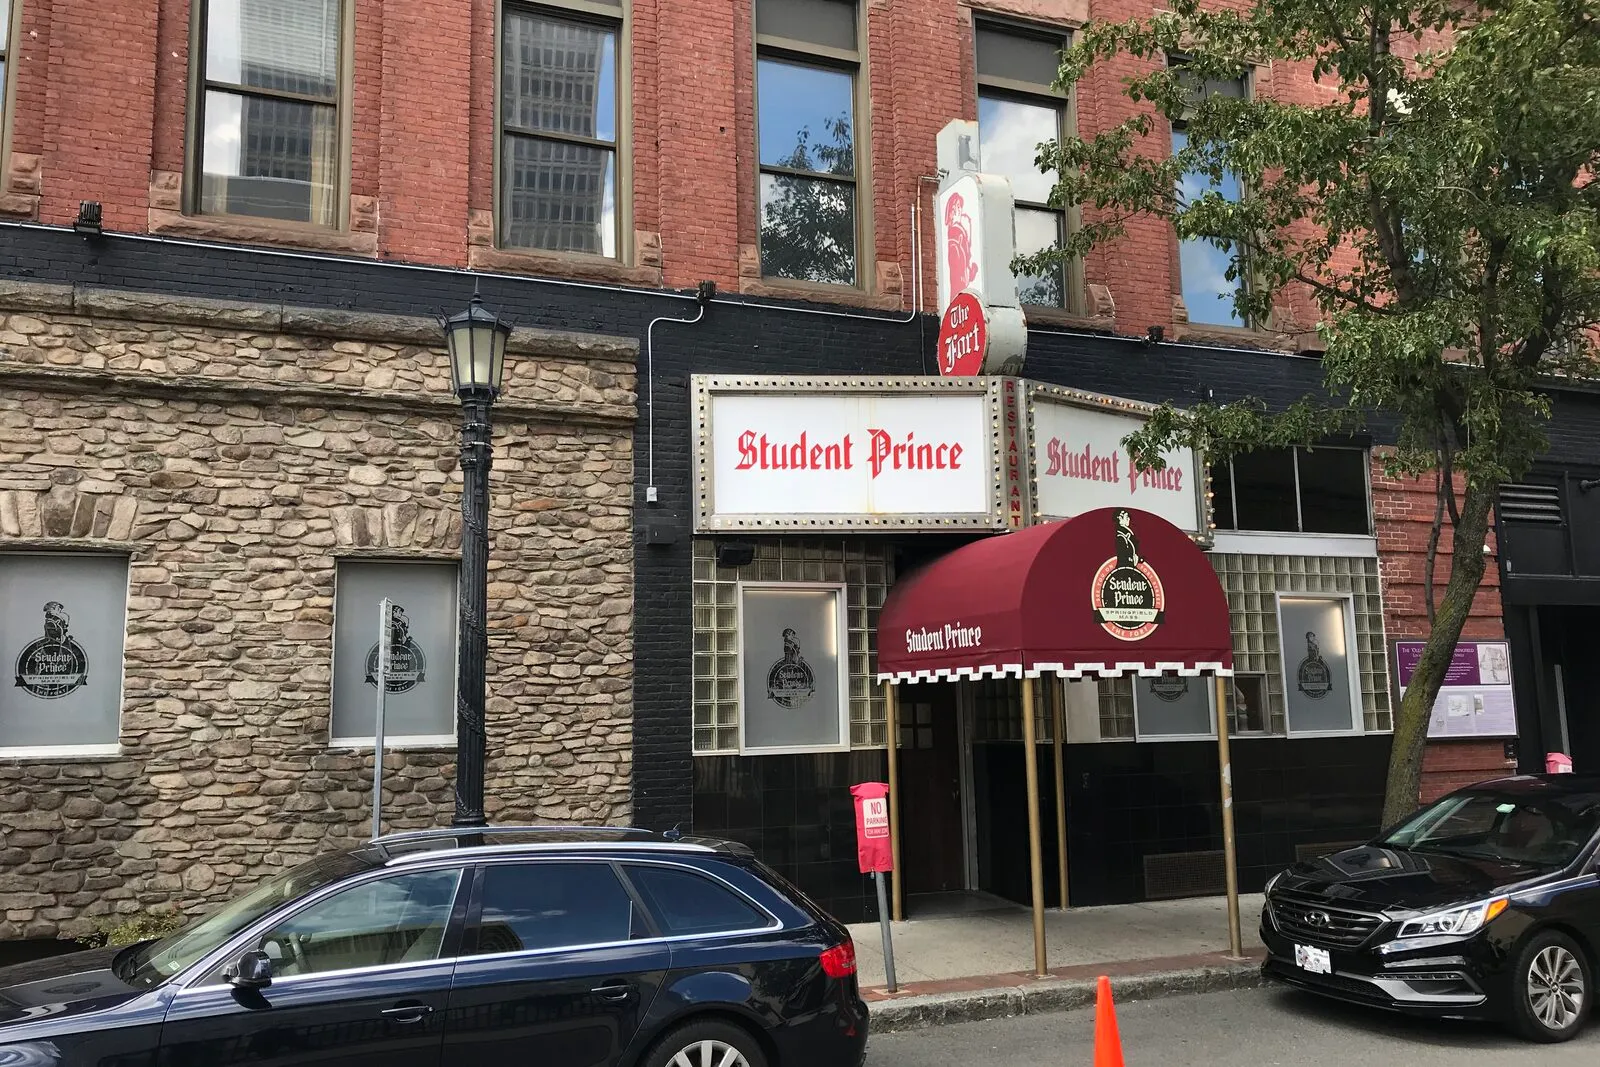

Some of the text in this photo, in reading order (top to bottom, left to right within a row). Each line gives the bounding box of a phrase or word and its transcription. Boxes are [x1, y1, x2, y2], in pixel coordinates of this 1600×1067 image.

[950, 304, 970, 329] The
[945, 322, 980, 373] Fort
[735, 429, 963, 480] Student Prince
[1005, 380, 1021, 527] RESTAURANT
[1045, 436, 1119, 484] Student
[1109, 576, 1147, 591] Student
[1114, 591, 1144, 607] Prince
[905, 621, 981, 653] Student Prince
[1111, 626, 1149, 638] THE FORT
[34, 651, 72, 663] Student
[870, 801, 882, 815] NO
